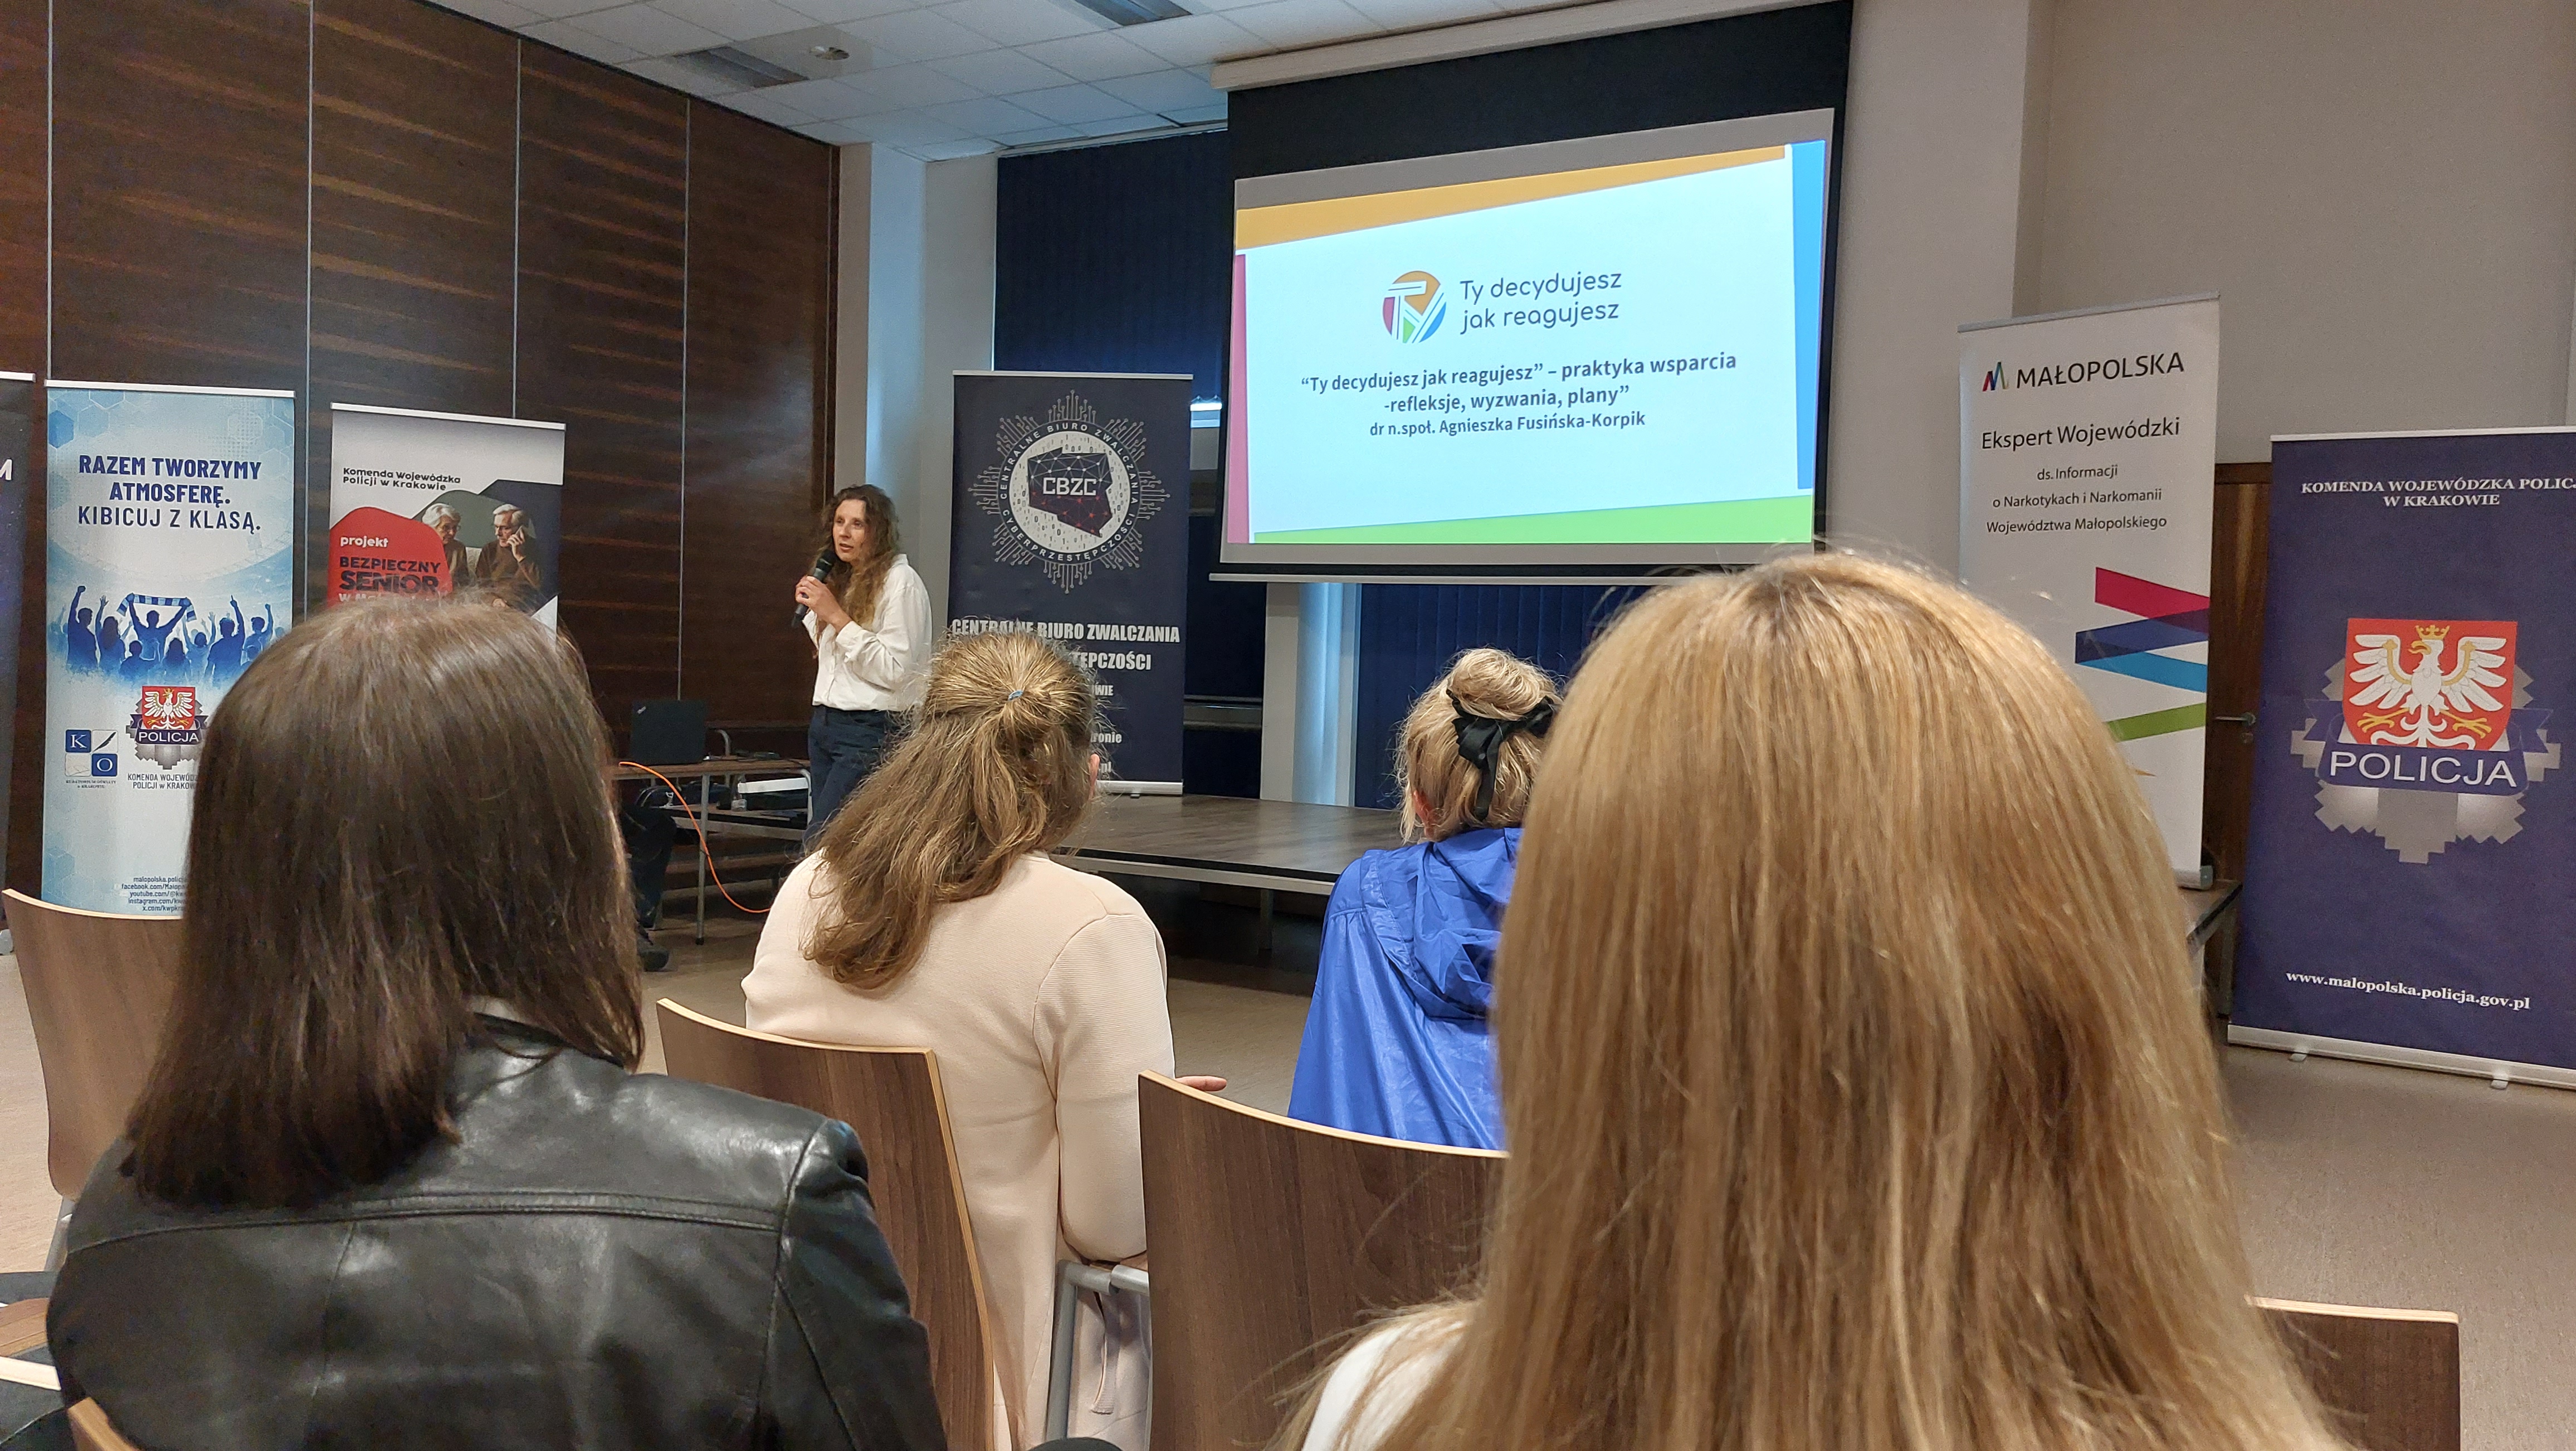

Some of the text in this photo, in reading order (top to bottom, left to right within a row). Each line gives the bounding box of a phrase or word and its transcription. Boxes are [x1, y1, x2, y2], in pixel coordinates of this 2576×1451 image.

[1459, 271, 1622, 305] Ty decydujesz
[1460, 301, 1619, 335] jak reagujesz
[1331, 369, 1419, 392] decydujesz
[1422, 369, 1447, 389] jak
[1561, 358, 1645, 382] praktyka
[1650, 351, 1736, 376] wsparcia
[2016, 351, 2185, 389] MAŁOPOLSKA
[1384, 393, 1466, 414] -refleksje,
[1470, 388, 1563, 412] wyzwania,
[1369, 411, 1646, 437] dr n.społ. Agnieszka Fusińska-Korpik
[1981, 417, 2180, 451] Ekspert Wojewódzki
[79, 454, 262, 480] RAZEM TWORZYMY
[1000, 422, 1139, 504] CENTRALNE BIURO ZWALCZANIA
[2037, 464, 2119, 481] ds. Informacji
[343, 468, 461, 484] Komenda Wojewódzka
[343, 475, 377, 487] Policji
[393, 480, 447, 491] Krakowie
[1042, 477, 1097, 496] CBZC
[2301, 480, 2385, 495] KOMENDA
[2388, 476, 2515, 493] WOJEWÓDZKA
[109, 481, 231, 508] ATMOSFERĘ.
[1992, 488, 2162, 508] o Narkotykach i Narkomanii
[2383, 494, 2500, 508] W KRAKOWIE
[78, 505, 262, 535] KIBICUJ Z KLASĄ.
[1986, 515, 2168, 535] Województwa Małopolskiego
[340, 535, 389, 548] projekt
[339, 556, 441, 573] BEZPIECZNY
[339, 570, 440, 595] SENIOR
[1037, 621, 1084, 640] BIURO
[1086, 624, 1181, 643] ZWALCZANIA
[70, 734, 87, 749] K
[139, 731, 199, 743] POLICJA
[127, 773, 158, 781] KOMENDA
[2330, 751, 2518, 787] POLICJA
[2286, 971, 2531, 1011] www.malopolska.policja.gov.pl
